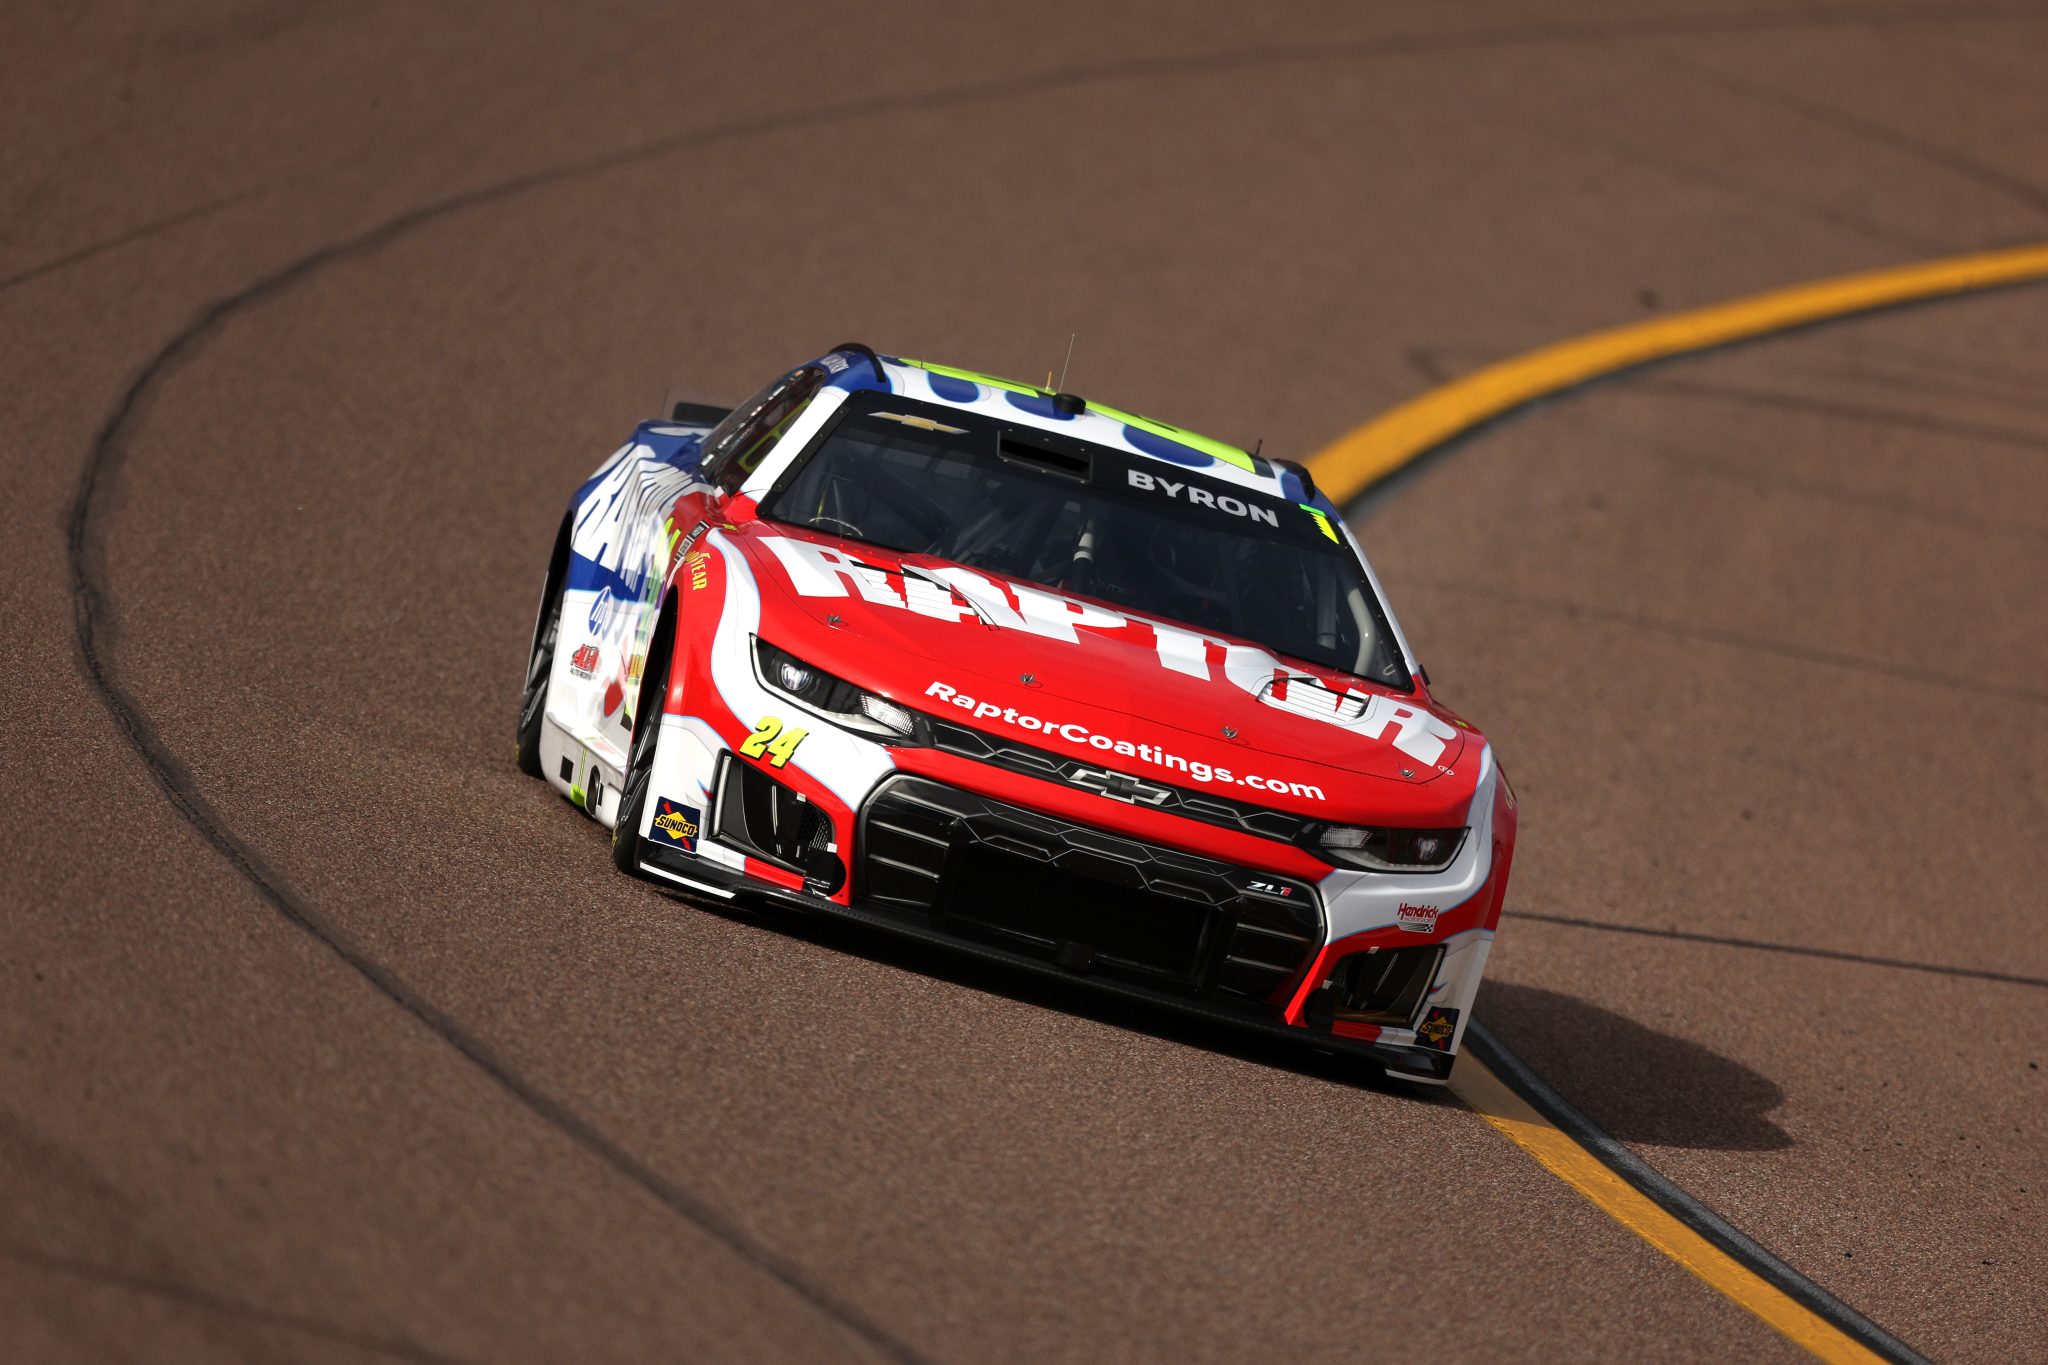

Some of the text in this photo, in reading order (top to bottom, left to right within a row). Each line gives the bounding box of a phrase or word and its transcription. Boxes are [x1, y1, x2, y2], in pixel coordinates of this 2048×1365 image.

[1128, 469, 1279, 528] BYRON
[756, 536, 1457, 766] RAPTOR
[739, 715, 809, 769] 24
[925, 681, 1326, 801] RaptorCoatings.com
[656, 815, 697, 837] SUNOCO
[1246, 880, 1293, 897] ZL1
[1397, 902, 1439, 920] Hendrick
[1421, 1022, 1451, 1037] SUNOCO
